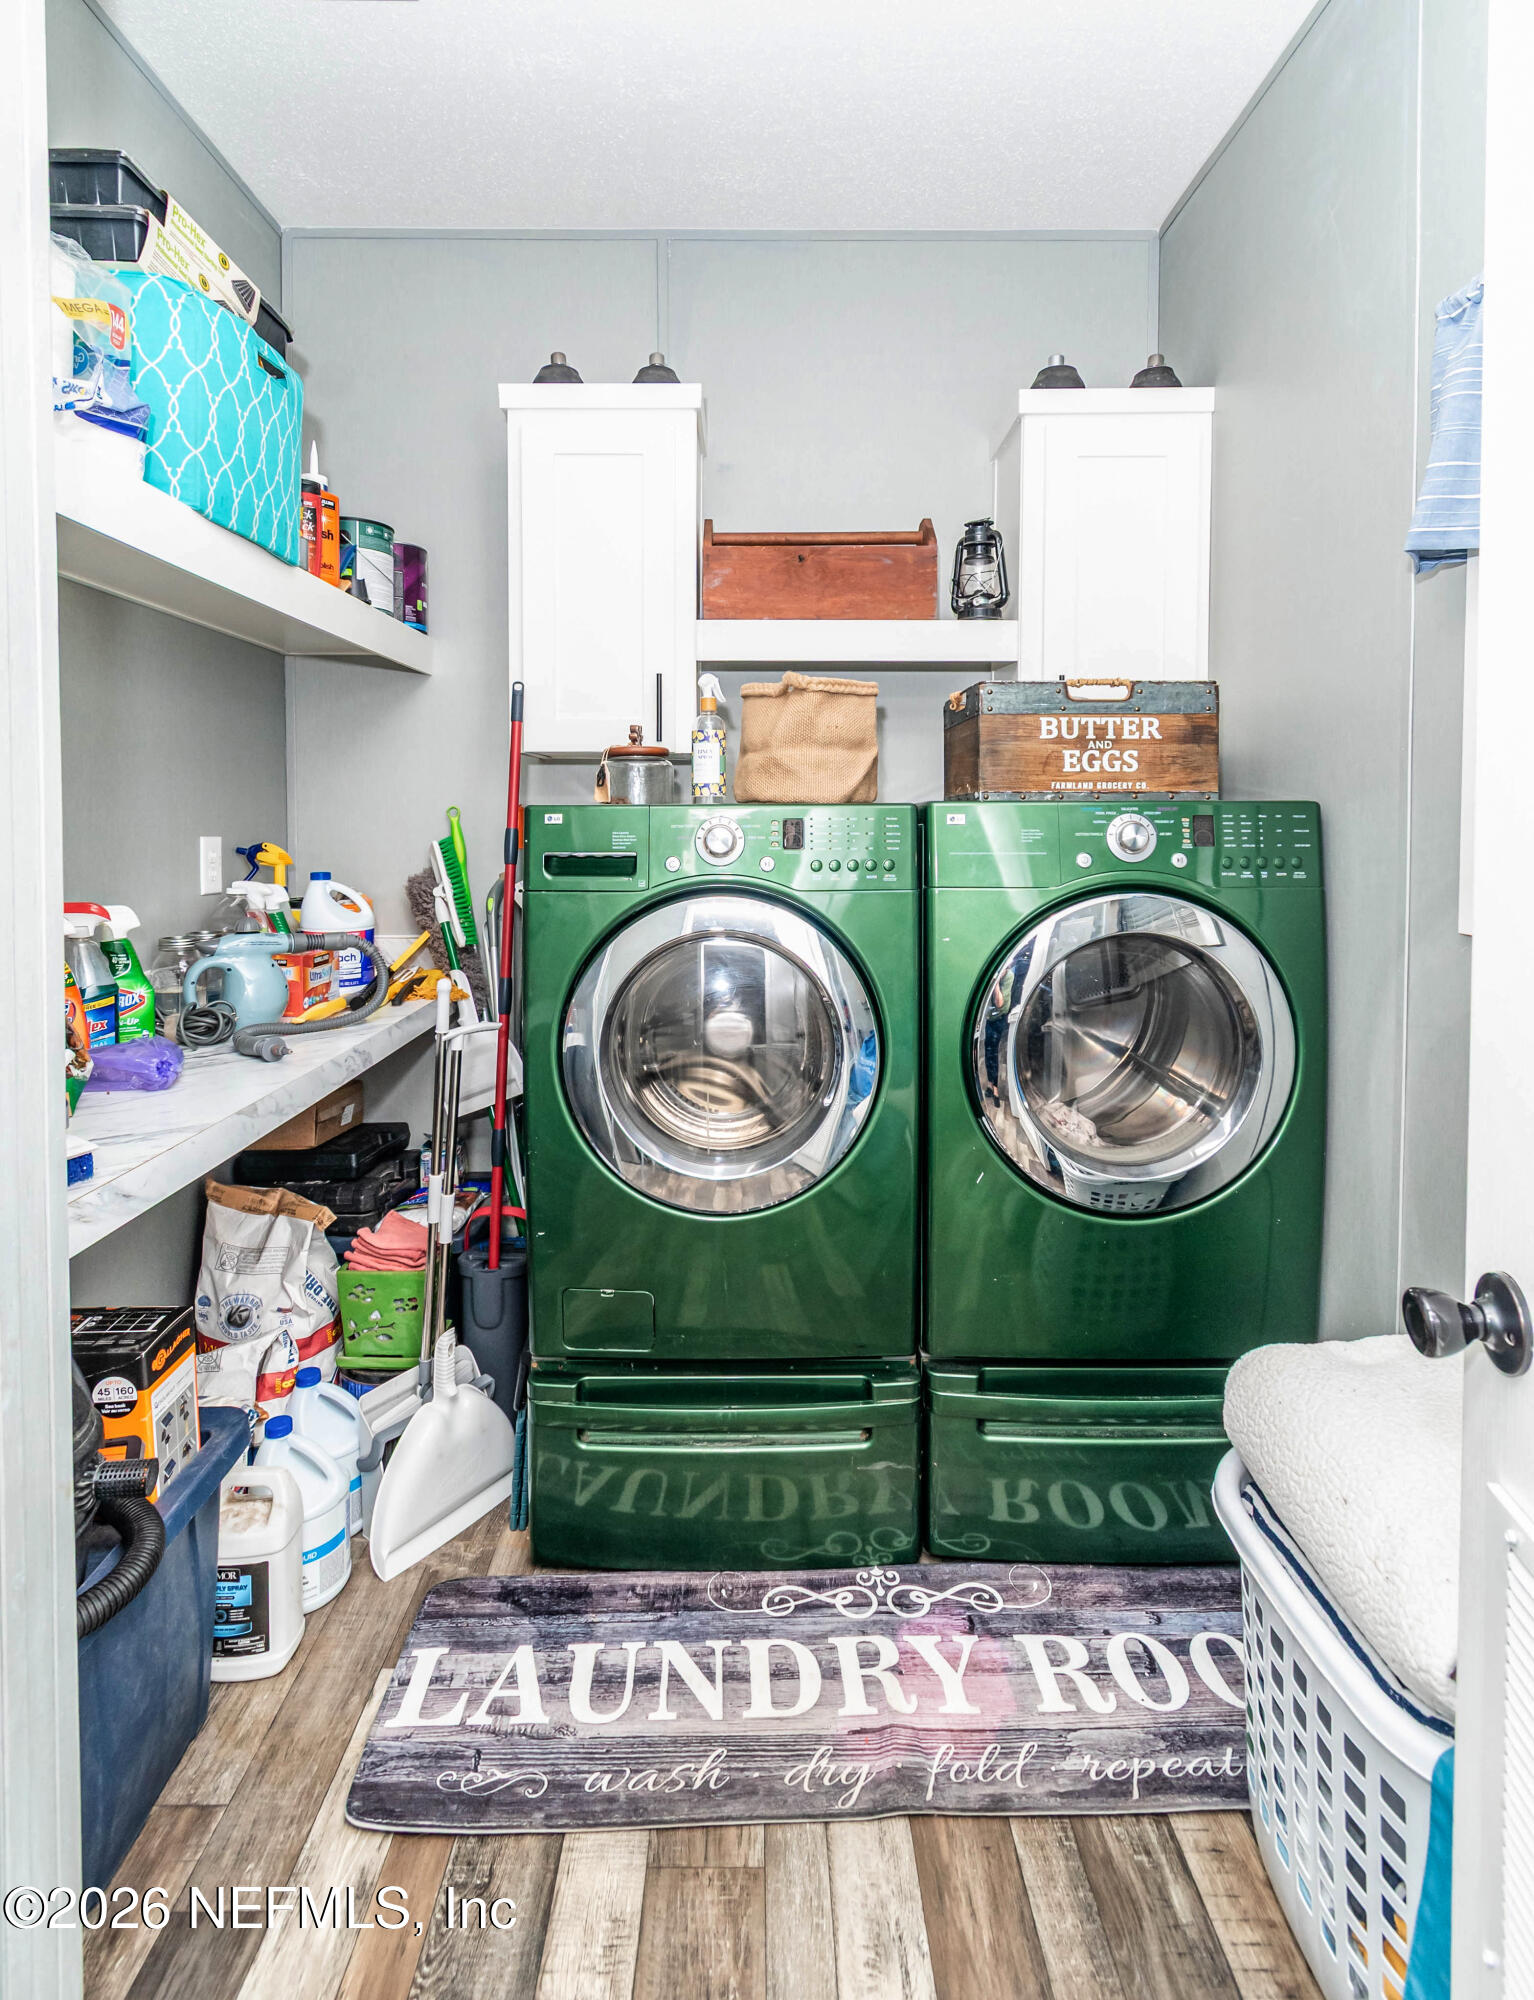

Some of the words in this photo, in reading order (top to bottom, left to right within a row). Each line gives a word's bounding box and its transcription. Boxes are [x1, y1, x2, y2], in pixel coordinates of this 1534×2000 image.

[171, 204, 206, 249] Pro-Hex
[156, 227, 191, 270] Pro-Hex
[62, 302, 99, 314] MEGA
[1039, 716, 1163, 739] BUTTER
[1087, 740, 1113, 750] AND
[1062, 749, 1139, 772] EGGS
[1050, 781, 1094, 790] FARMLAND
[1096, 781, 1133, 790] GROCERY
[1135, 781, 1150, 790] CO.
[279, 1317, 293, 1325] USA
[97, 1387, 110, 1396] 45
[115, 1386, 134, 1395] 160
[227, 1584, 248, 1592] SPRAY
[384, 1635, 981, 1729] LAUNDRY
[1012, 1631, 1247, 1714] ROO
[584, 1747, 731, 1794] wash
[783, 1744, 876, 1810] dry
[925, 1741, 1039, 1802] fold
[1081, 1747, 1244, 1801] repeat
